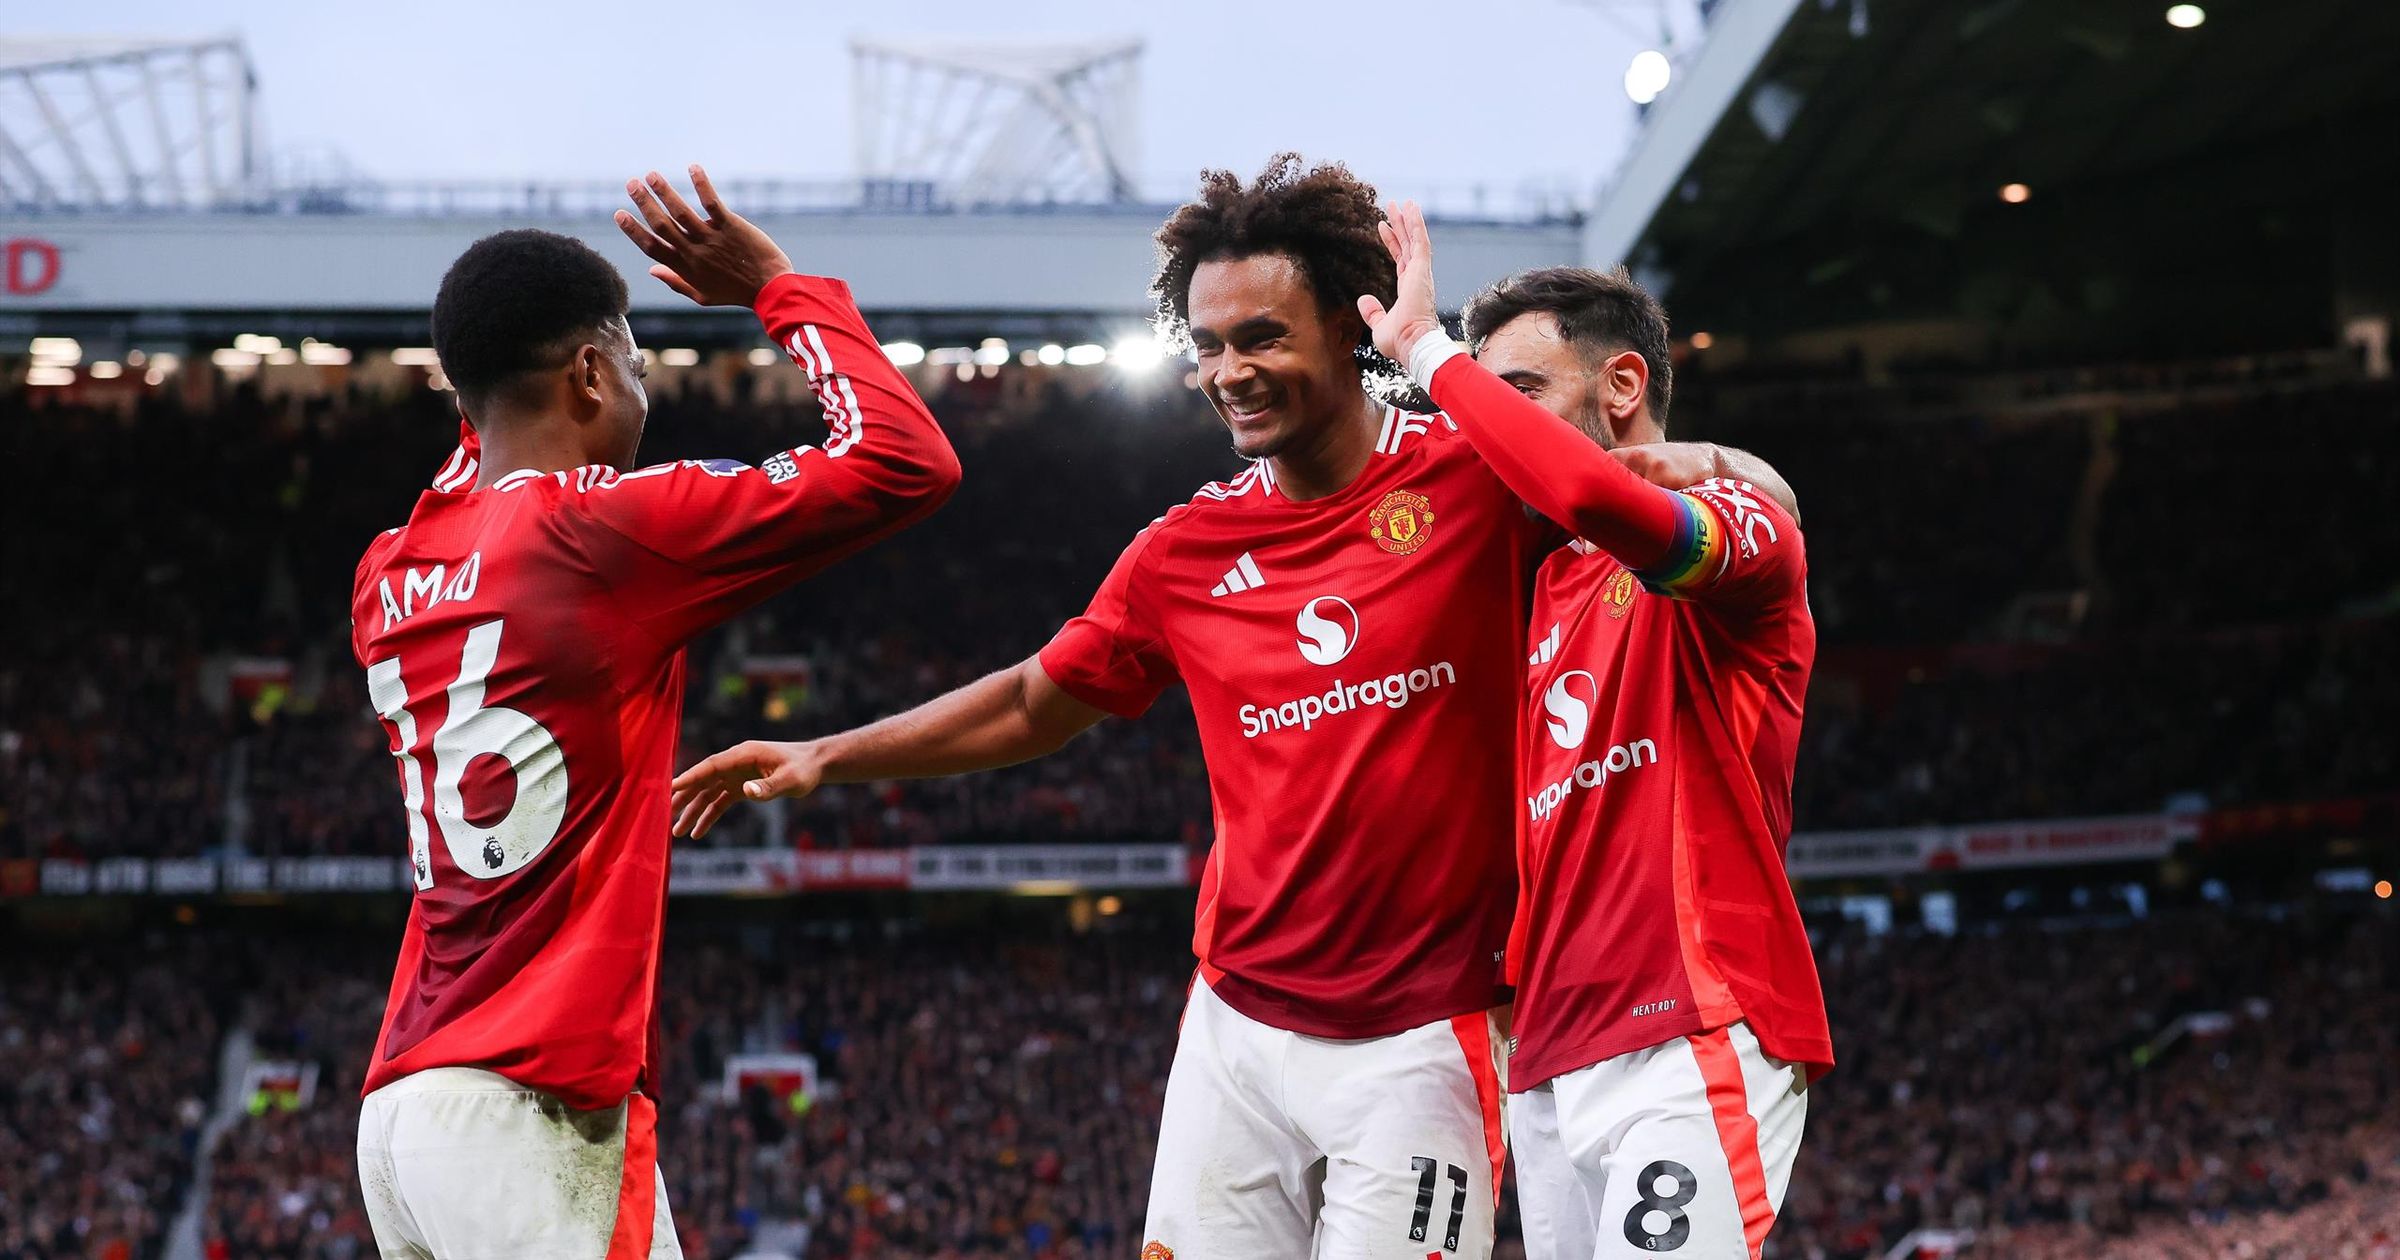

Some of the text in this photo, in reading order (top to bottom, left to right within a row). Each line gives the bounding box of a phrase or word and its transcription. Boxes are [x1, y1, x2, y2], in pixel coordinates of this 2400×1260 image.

[1375, 495, 1425, 522] MANCHESTER
[1389, 534, 1425, 551] UNITED
[1239, 661, 1456, 738] Snapdragon
[367, 619, 569, 891] 16
[1408, 1156, 1468, 1252] 11
[1623, 1160, 1697, 1251] 8
